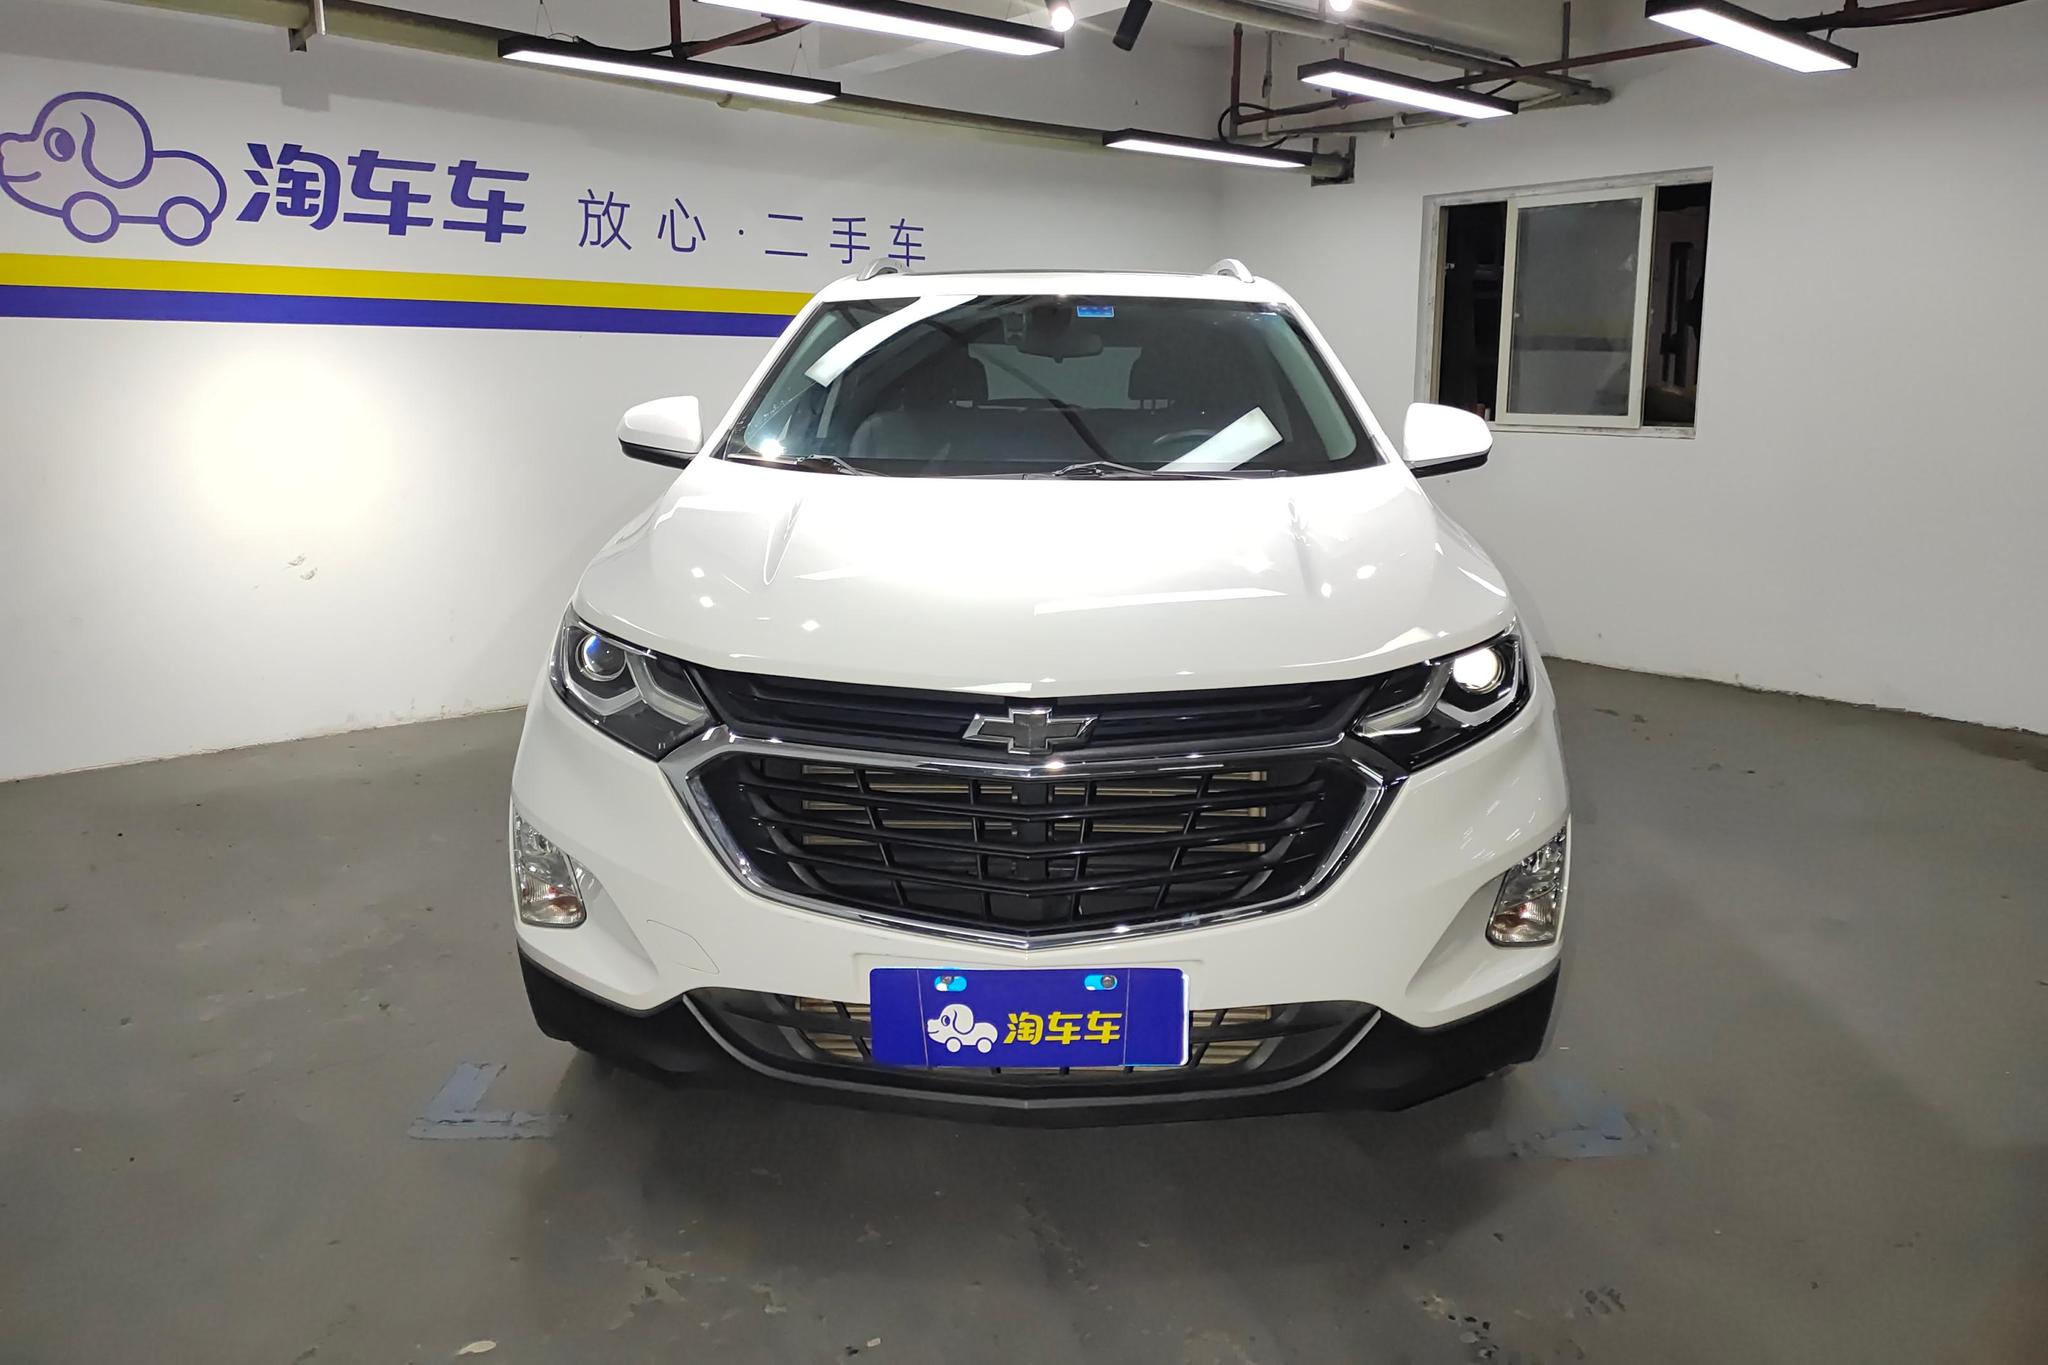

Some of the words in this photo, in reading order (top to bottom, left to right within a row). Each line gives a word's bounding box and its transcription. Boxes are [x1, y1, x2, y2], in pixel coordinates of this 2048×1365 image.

[236, 143, 530, 243] 淘车车
[1004, 1010, 1122, 1045] 淘车车
